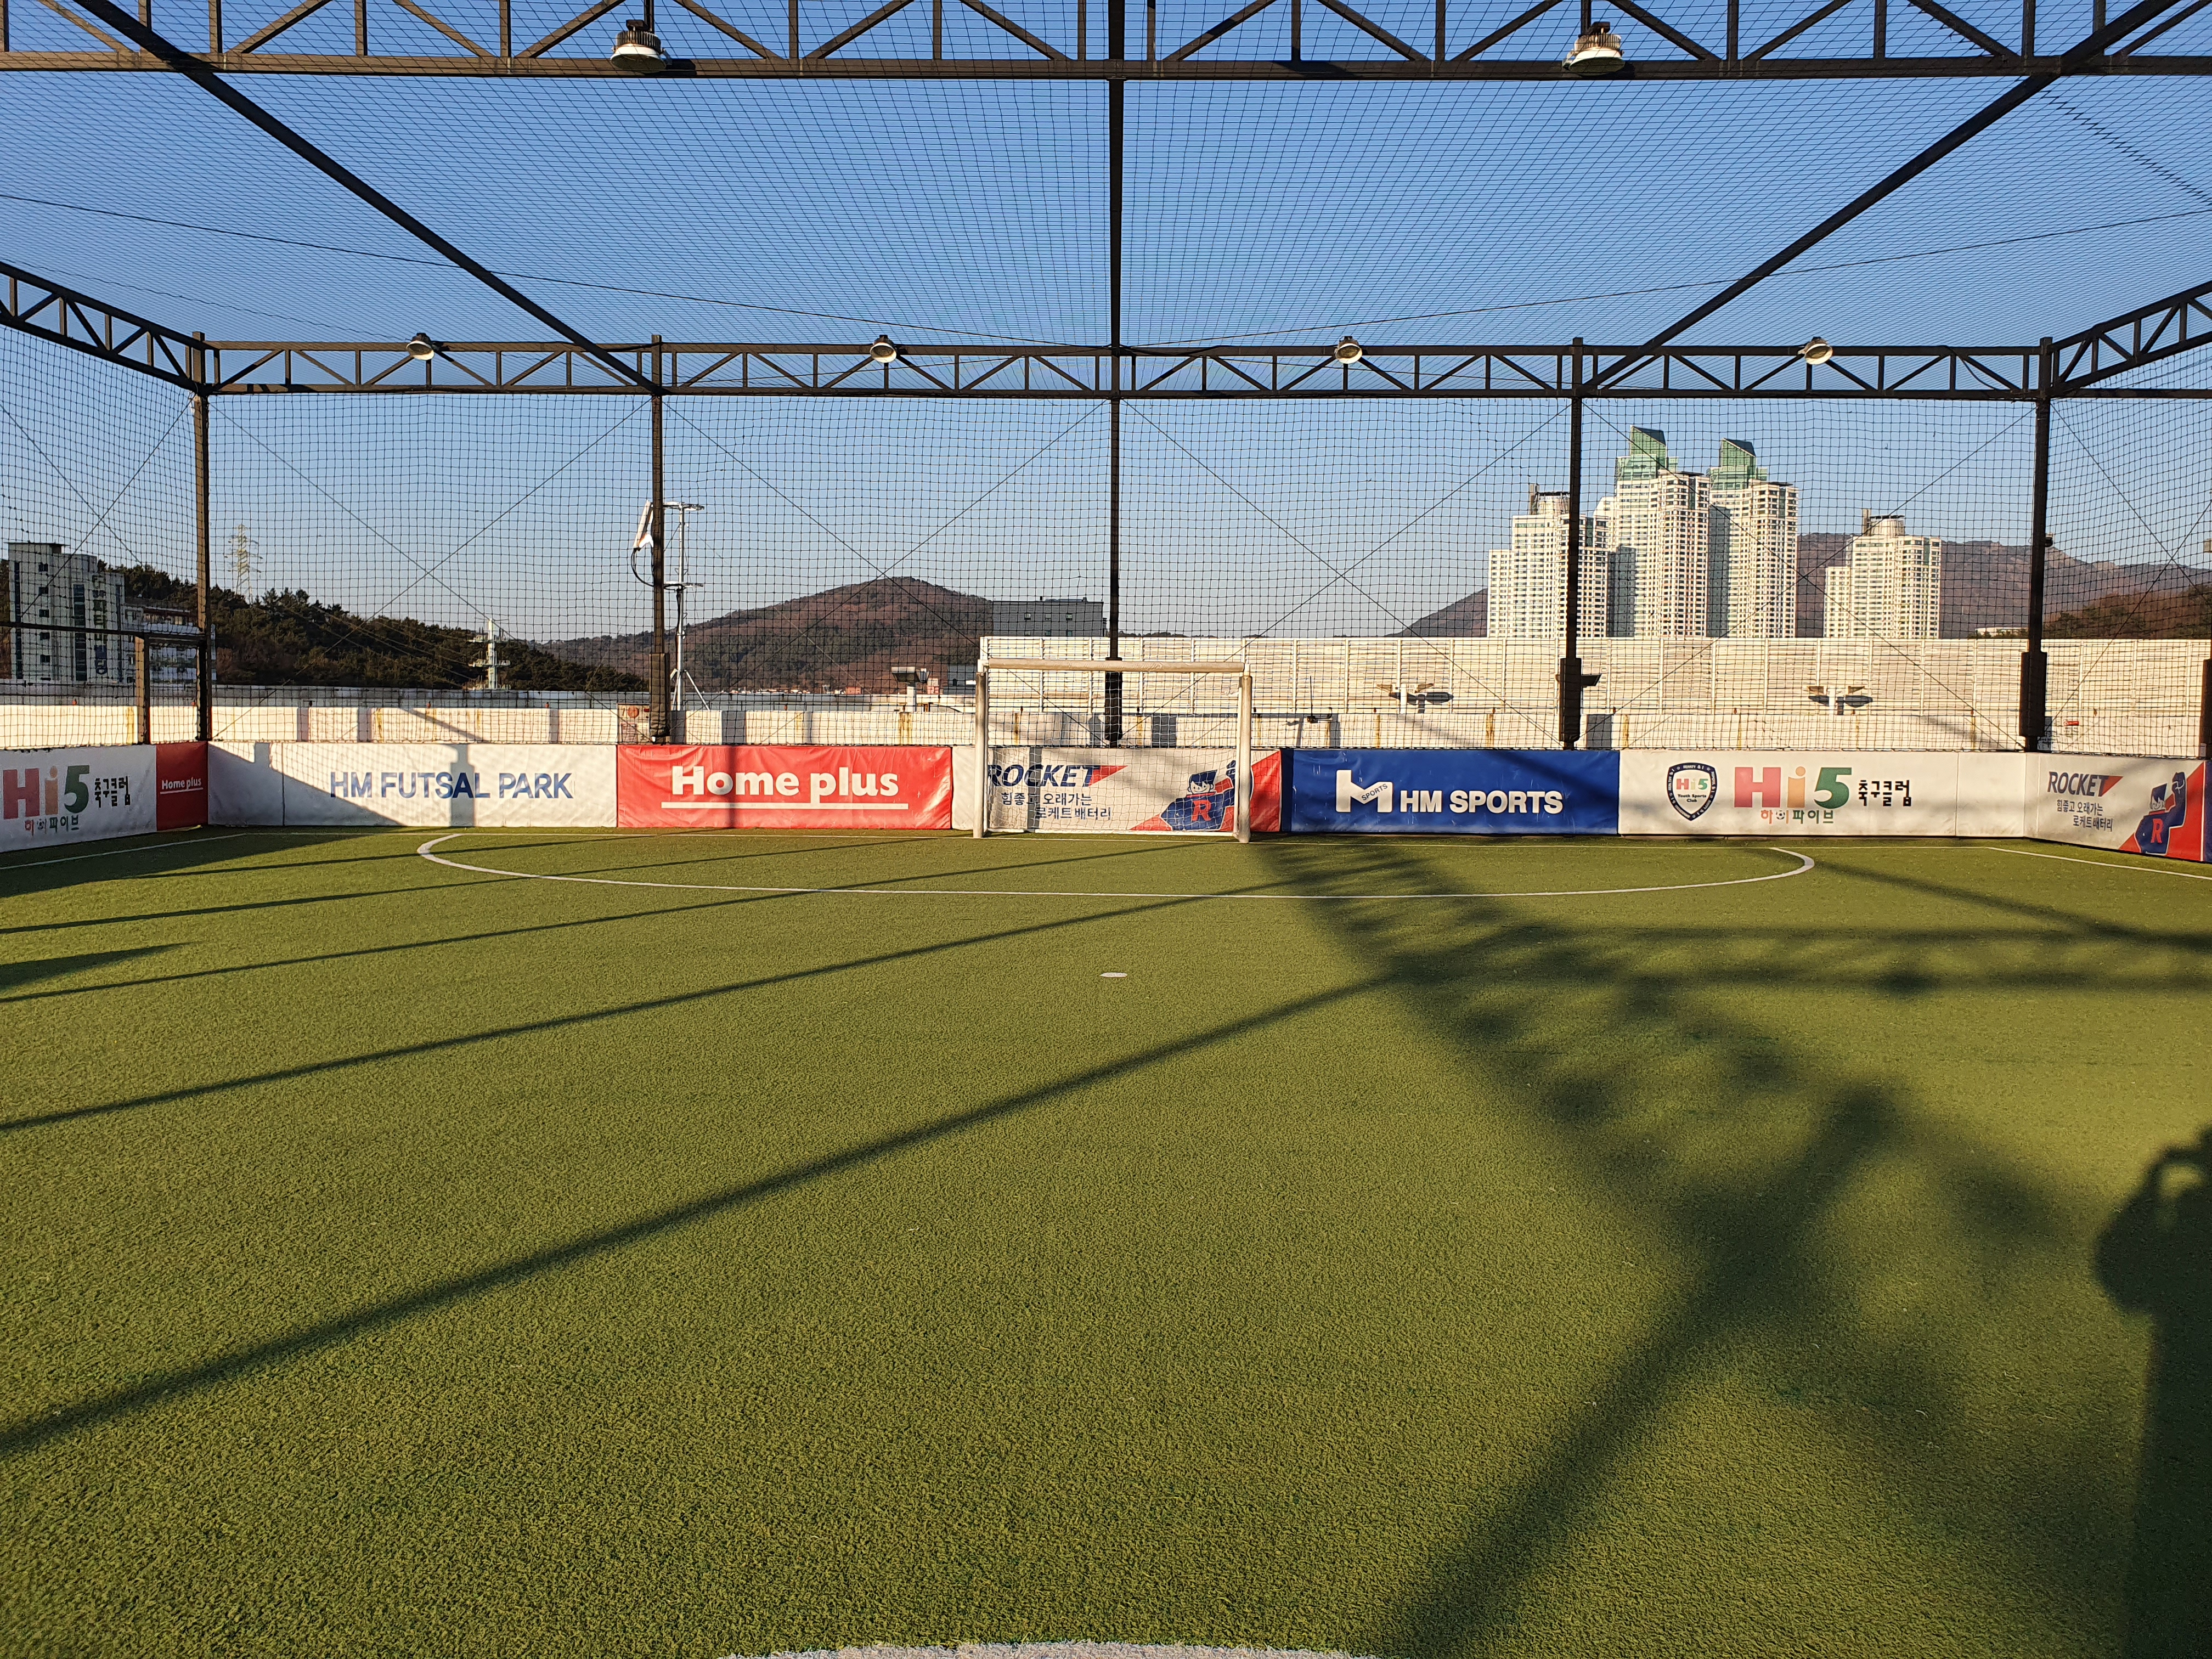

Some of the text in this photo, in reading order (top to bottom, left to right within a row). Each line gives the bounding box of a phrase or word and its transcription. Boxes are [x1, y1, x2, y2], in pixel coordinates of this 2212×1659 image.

[161, 776, 202, 791] Home plus
[330, 772, 574, 799] HM FUTSAL PARK
[672, 766, 899, 804] Home plus
[987, 764, 1101, 787] ROCKET
[1676, 778, 1708, 790] Hi5
[1734, 766, 1852, 809] Hi5
[2047, 771, 2109, 797] ROCKET
[3, 765, 89, 820] Hi5
[94, 776, 131, 808] 축구클럽
[1001, 792, 1092, 806] 힘좋고 오래가는
[1361, 783, 1388, 800] SPORTS
[1400, 790, 1564, 814] HM SPORTS
[1858, 780, 1912, 806] 축구클럽
[1075, 806, 1111, 820] 배터리
[2057, 799, 2103, 816] 힘좋고 오래가는
